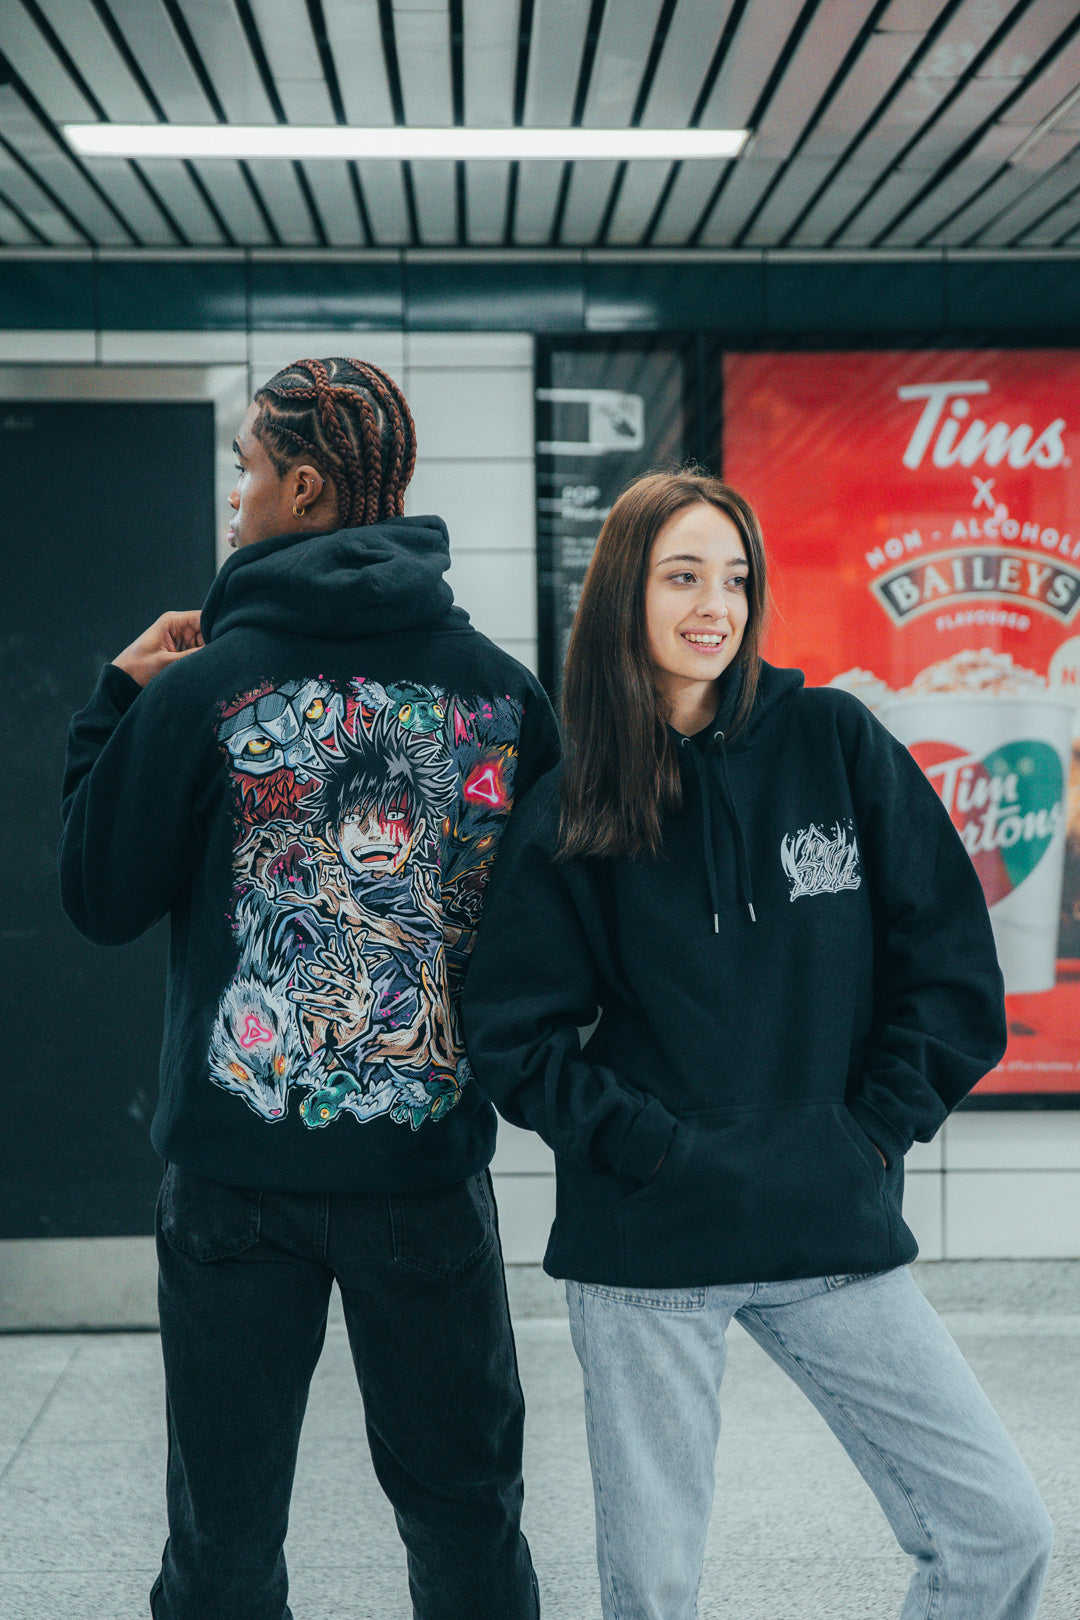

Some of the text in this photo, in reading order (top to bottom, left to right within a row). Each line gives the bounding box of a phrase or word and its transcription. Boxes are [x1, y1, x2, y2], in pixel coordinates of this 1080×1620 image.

[898, 380, 1066, 470] Tims
[865, 529, 922, 570] NON
[888, 555, 1077, 610] BAILEYS
[926, 752, 1018, 815] Tim
